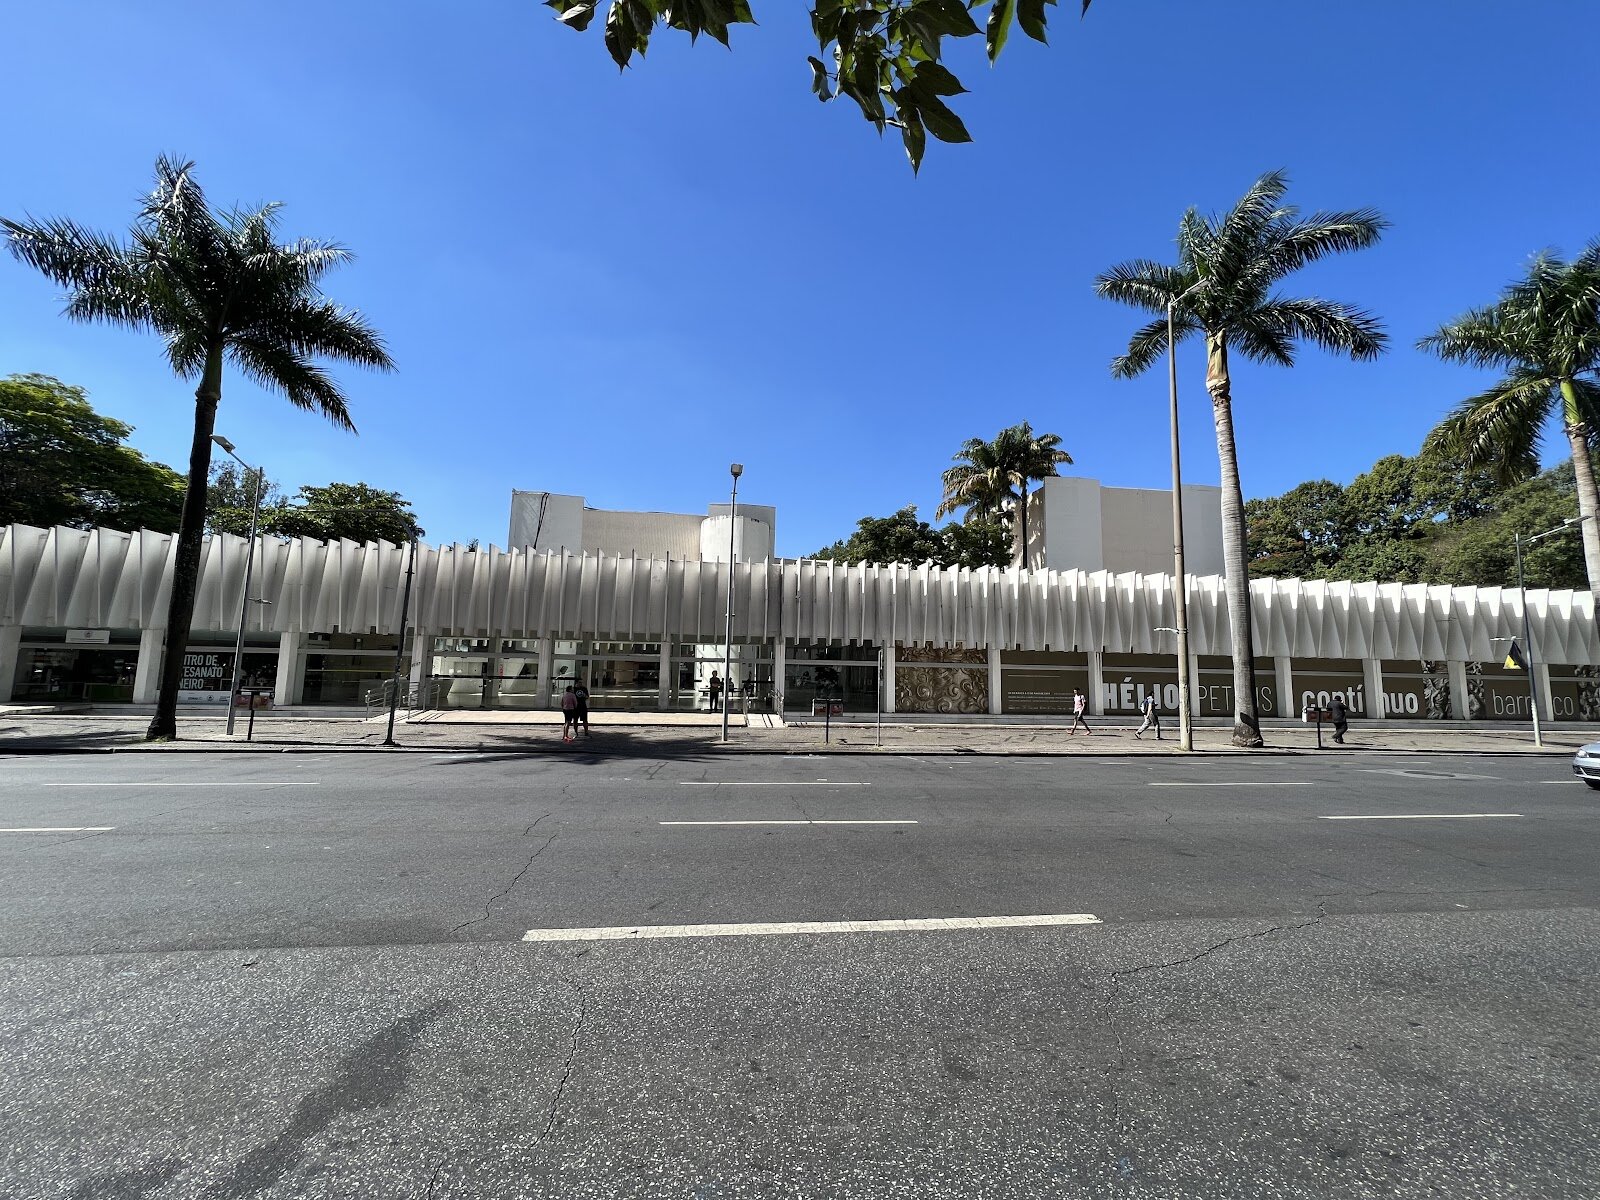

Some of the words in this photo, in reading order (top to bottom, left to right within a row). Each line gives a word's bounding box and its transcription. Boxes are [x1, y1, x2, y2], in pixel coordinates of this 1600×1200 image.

[205, 654, 219, 666] DE
[179, 678, 204, 689] NEIRO
[1103, 676, 1179, 710] HÉLIO
[1198, 685, 1273, 712] PETS
[1492, 688, 1574, 716] barrco
